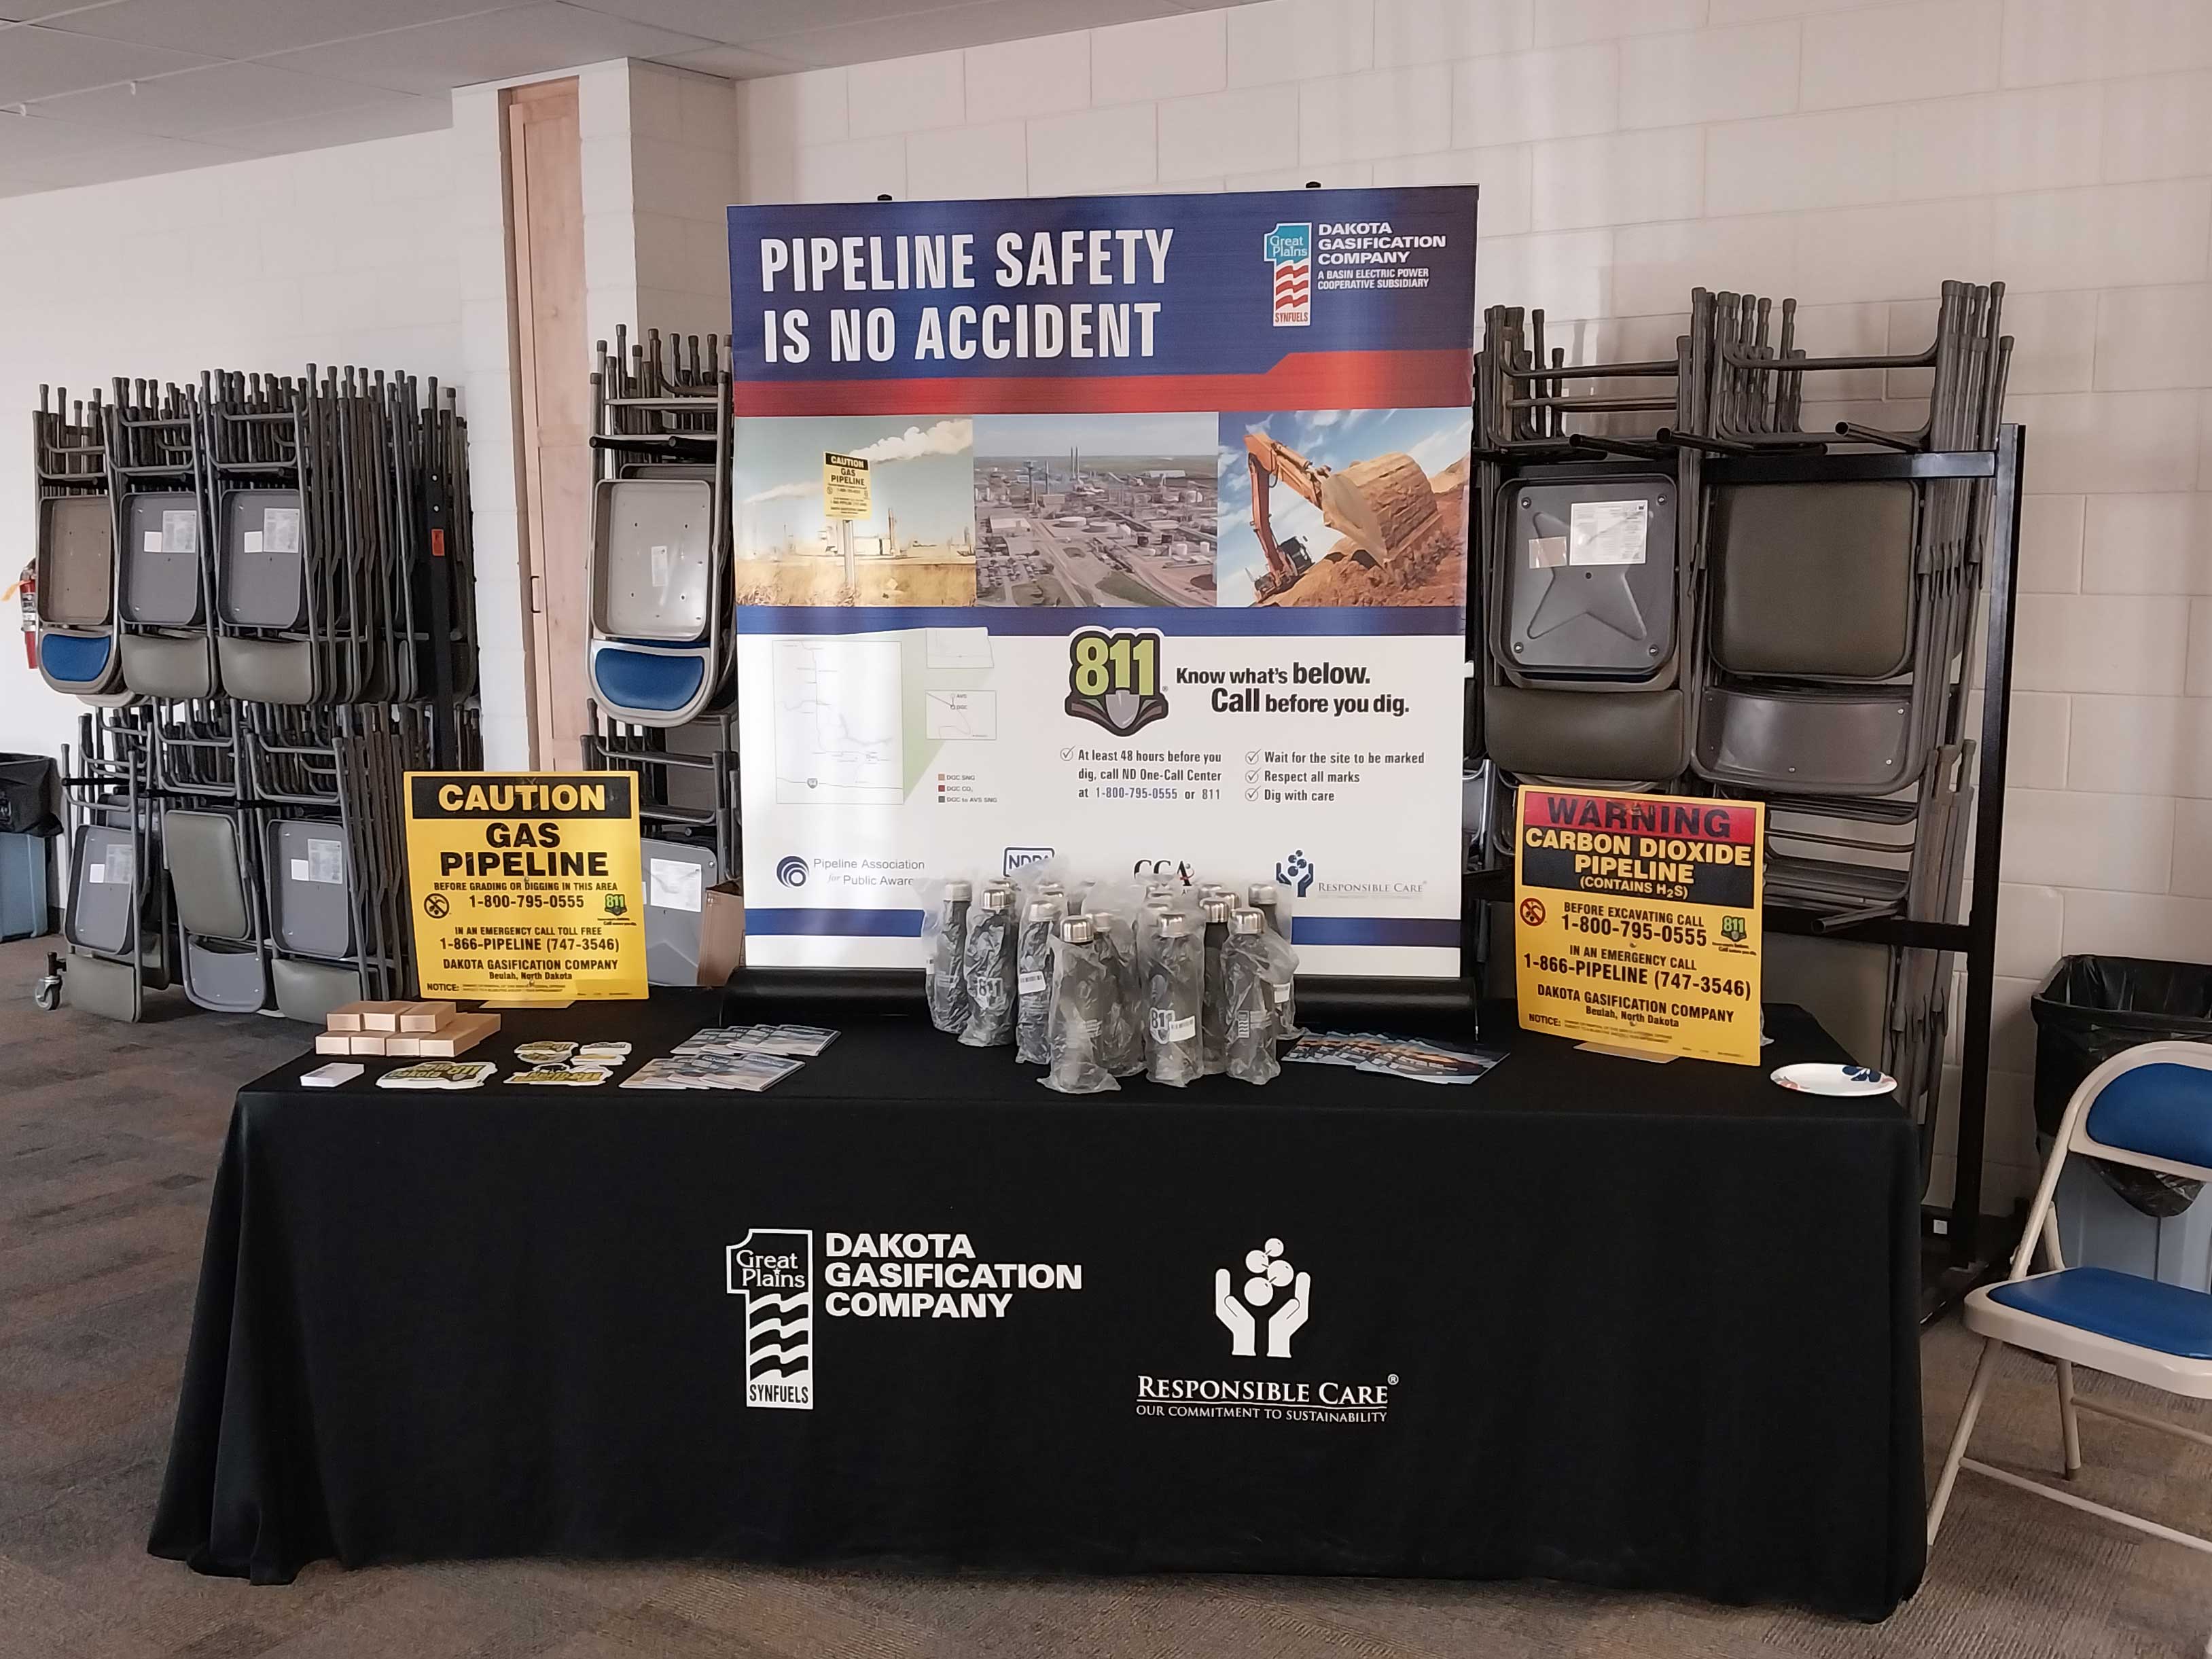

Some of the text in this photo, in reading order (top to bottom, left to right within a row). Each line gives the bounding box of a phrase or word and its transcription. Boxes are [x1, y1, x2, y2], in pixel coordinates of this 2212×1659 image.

[1319, 222, 1392, 236] DAKOTA
[1270, 235, 1304, 247] Great
[1318, 236, 1446, 250] GASIFICATION
[1272, 246, 1308, 257] Plains
[1318, 251, 1411, 265] COMPANY
[761, 228, 1174, 292] PIPELINE SAFETY
[1318, 268, 1429, 280] A BASIN ELECTRIC POWER
[1317, 279, 1429, 290] COOPERATIVE SUBSIDIARY
[1274, 312, 1308, 323] SYNFUELS
[764, 300, 1162, 364] IS NO ACCIDENT
[831, 456, 864, 468] CAUTION
[841, 468, 856, 476] GAS
[831, 475, 865, 486] PIPELINE
[1076, 637, 1154, 696] 811
[1176, 662, 1371, 685] Know what's below.
[1211, 688, 1410, 717] Call before you dig.
[1078, 751, 1221, 765] At least 48 hours before you
[1264, 752, 1424, 764] Wait for the site to be marked
[1078, 769, 1221, 783] dig, call ND One-Call Center
[1264, 771, 1360, 785] Respect all marks
[438, 784, 605, 811] CAUTION
[1078, 787, 1221, 800] at 1-800-795-0555 or 811
[1264, 789, 1335, 803] Dig with care
[1548, 797, 1730, 838] WARNING
[486, 822, 560, 848] GAS
[1526, 827, 1751, 866] CARBON DIOXIDE
[441, 851, 609, 877] PIPELINE
[814, 858, 925, 870] Pipeline Association
[1009, 855, 1049, 870] ND
[1575, 854, 1694, 884] PIPELINE
[434, 882, 618, 891] BEFORE GRADING OR DIGGING IN THIS AREA
[843, 875, 876, 885] Public
[1580, 876, 1653, 894] (CONTAINS
[1318, 882, 1423, 893] RESPONSIBLE CARE
[469, 895, 584, 908] 1-800-795-0555
[606, 895, 624, 908] 811
[1564, 902, 1704, 927] BEFORE EXCAVATING CALL
[480, 927, 532, 935] EMERGENCY
[534, 927, 555, 935] CALL
[558, 927, 578, 935] TOLL
[581, 927, 602, 935] FREE
[1561, 914, 1707, 946] 1-800-795-0555
[1724, 917, 1744, 933] 811
[440, 938, 620, 952] 1-866-PIPELINE (747-3546)
[443, 959, 618, 970] DAKOTA GASIFICATION COMPANY
[1569, 945, 1697, 971] IN AN EMERGENCY CALL
[489, 971, 572, 980] Beulah, North Dakota
[1523, 953, 1751, 1001] 1-866-PIPELINE (747-3546)
[427, 983, 459, 992] NOTICE:
[1537, 984, 1734, 1022] DAKOTA GASIFICATION COMPANY
[1529, 1013, 1561, 1027] NOTICE:
[1586, 1005, 1679, 1027] Beulah, North Dakota
[825, 1232, 976, 1258] DAKOTA
[736, 1249, 798, 1270] Great
[742, 1268, 805, 1288] Plains
[825, 1262, 1082, 1289] GASIFICATION
[825, 1291, 1013, 1318] COMPANY
[749, 1384, 808, 1404] SYNFUELS
[1138, 1375, 1310, 1402] RESPONSIBLE
[1137, 1404, 1387, 1423] OUR COMMITMENT TO SUSTAINABILITY
